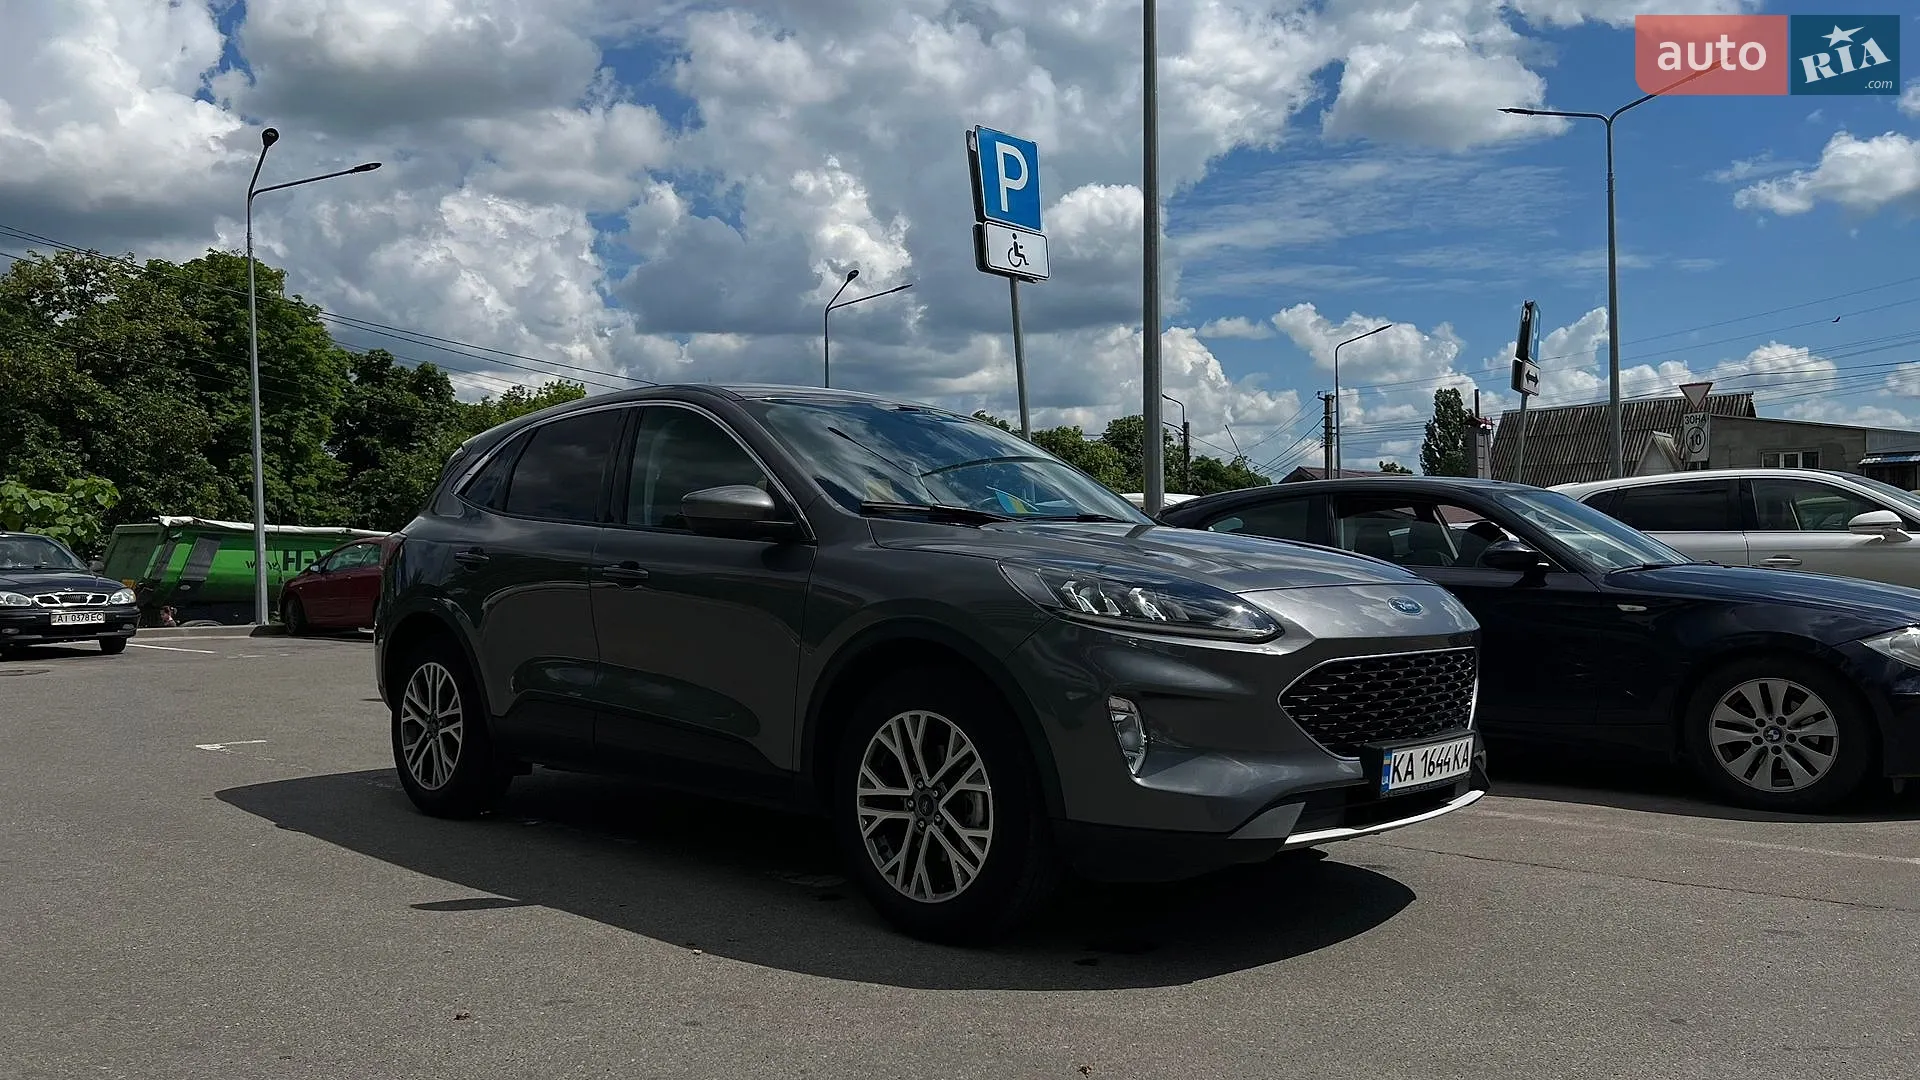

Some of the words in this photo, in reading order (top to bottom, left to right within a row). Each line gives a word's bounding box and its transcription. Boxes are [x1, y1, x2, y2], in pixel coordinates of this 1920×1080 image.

[995, 140, 1029, 212] P
[1690, 434, 1702, 447] 10
[1391, 752, 1415, 784] KA
